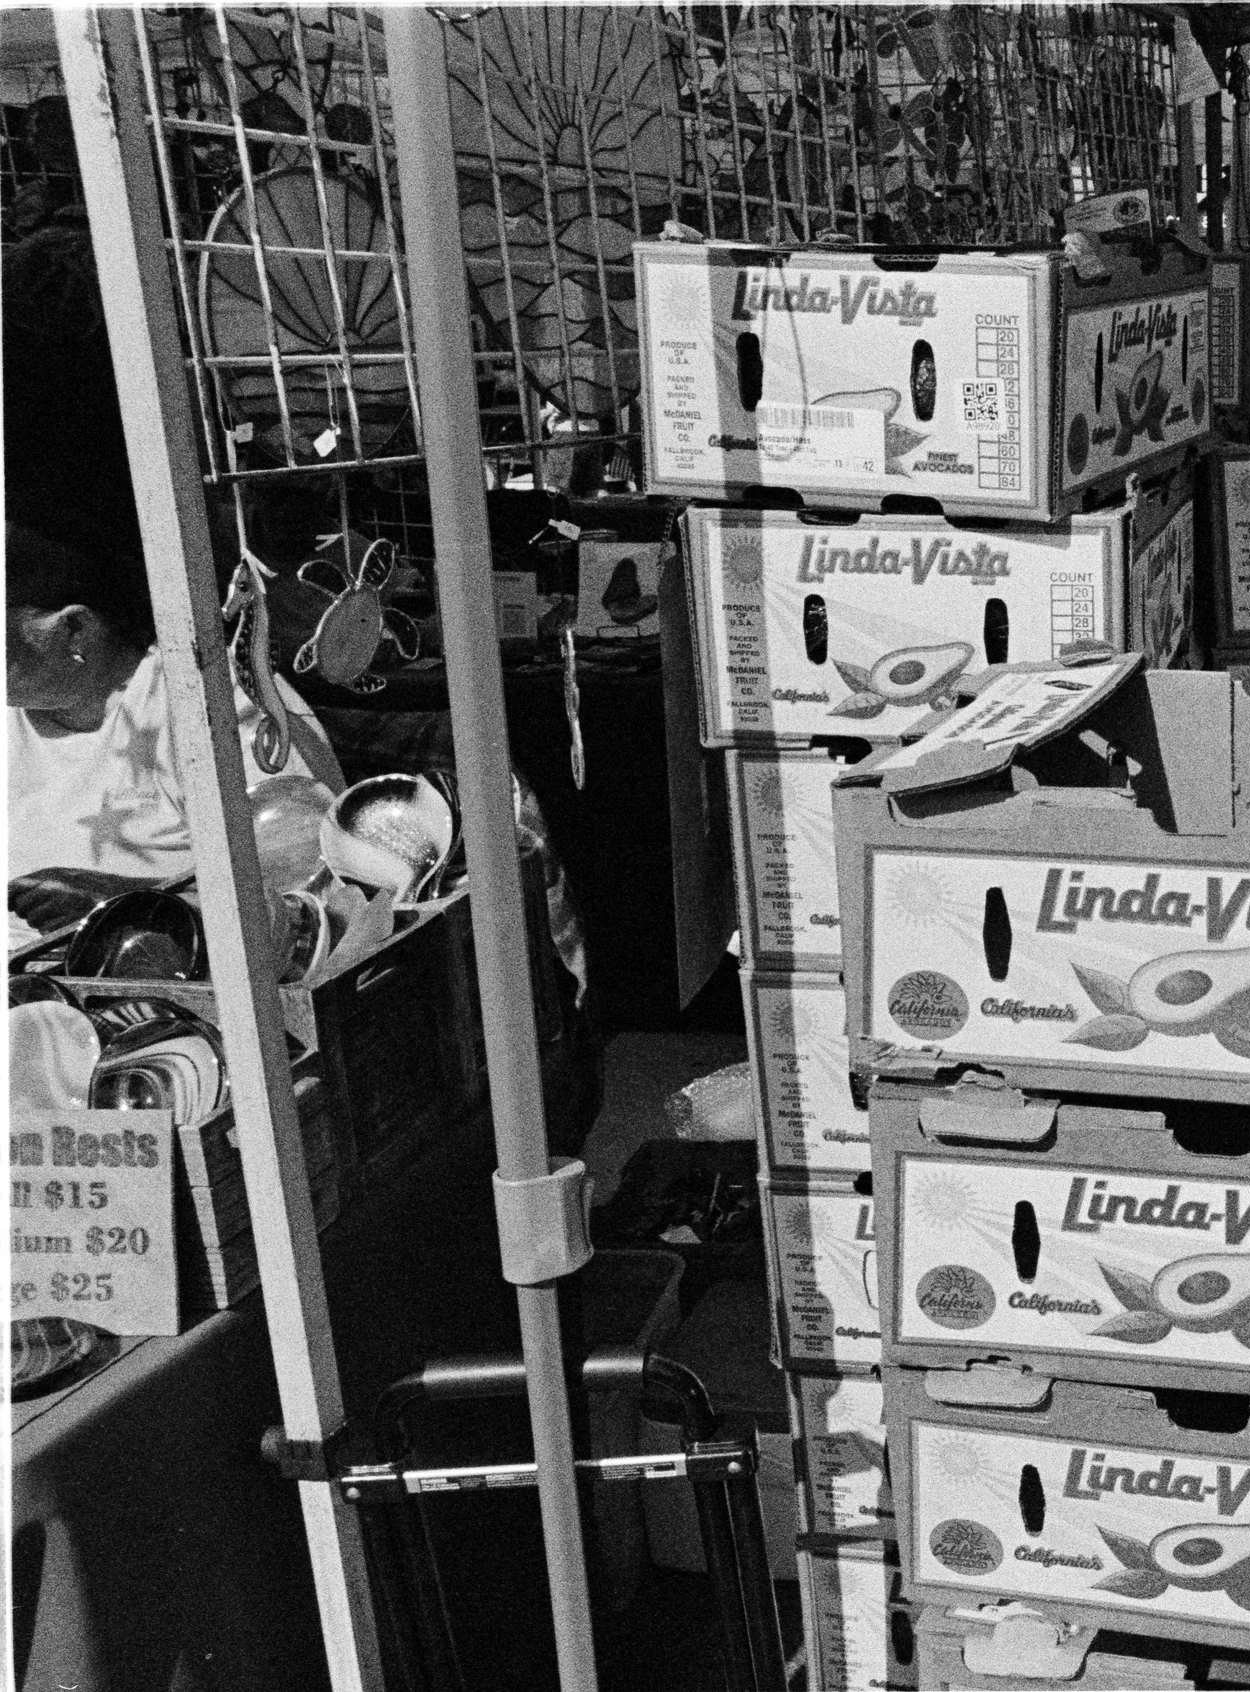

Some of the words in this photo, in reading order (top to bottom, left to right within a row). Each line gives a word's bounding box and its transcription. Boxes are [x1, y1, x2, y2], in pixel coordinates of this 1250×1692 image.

[731, 270, 939, 325] Linda-Vista
[975, 314, 1019, 325] COUNT
[1000, 331, 1015, 342] 20
[660, 341, 697, 350] PRODUCE
[1000, 348, 1015, 358] 24
[663, 409, 702, 420] McDANIEL
[1000, 447, 1015, 458] 60
[912, 461, 975, 474] AVOCADOS
[1000, 463, 1015, 473] 70
[1000, 478, 1015, 488] 84
[796, 535, 1011, 585] Linda-Vista
[1050, 571, 1093, 582] COUNT
[1073, 587, 1089, 598] 20
[722, 604, 761, 612] PRODUCE
[1073, 602, 1089, 613] 24
[726, 666, 767, 675] McDANIEL
[735, 677, 759, 685] FRUIT
[980, 998, 1079, 1023] California's
[51, 1125, 160, 1168] Rests
[44, 1180, 109, 1209] $15
[85, 1225, 150, 1256] $20
[50, 1272, 114, 1302] $25
[1008, 1291, 1102, 1315] California's
